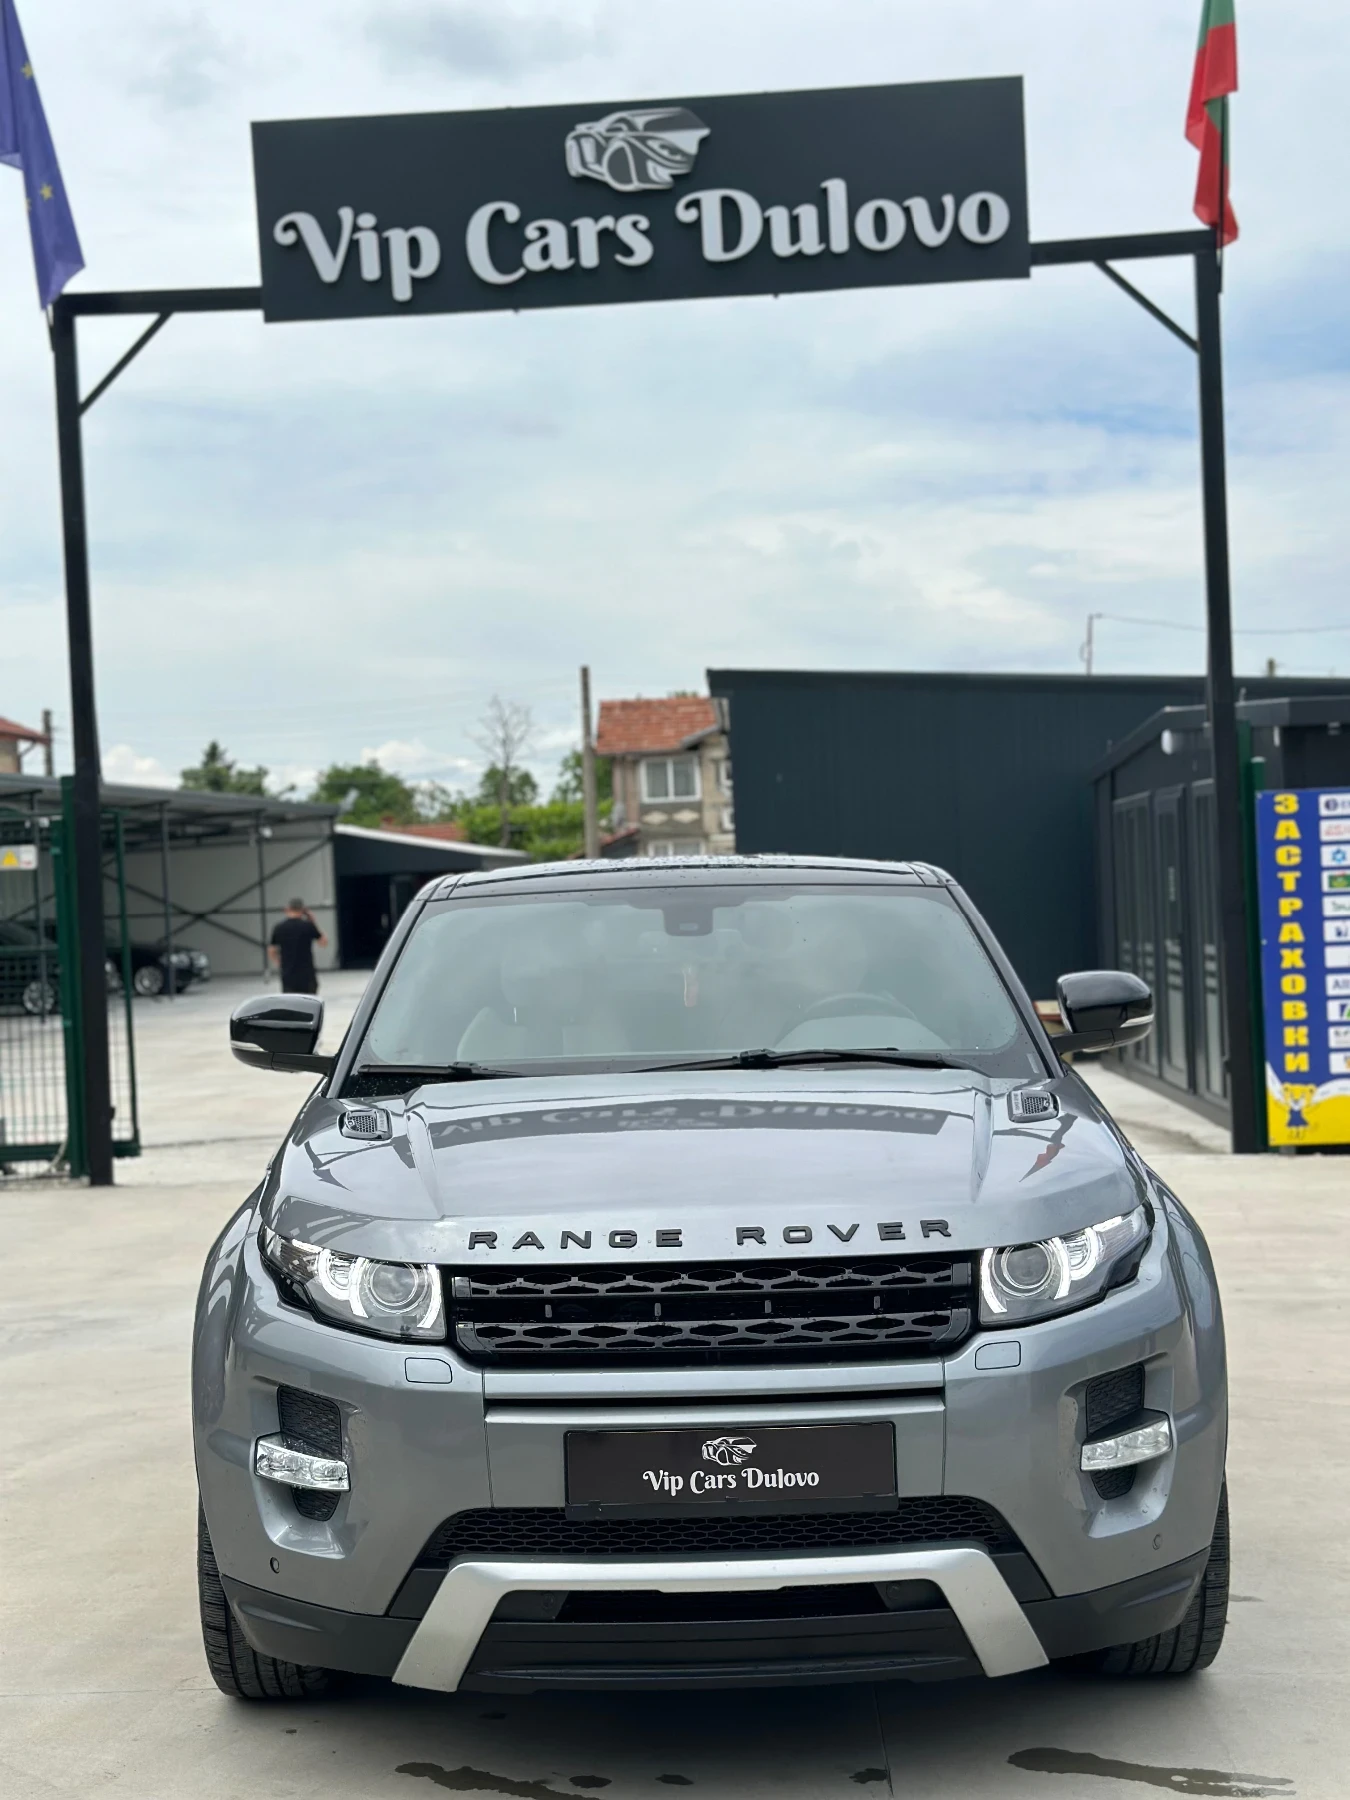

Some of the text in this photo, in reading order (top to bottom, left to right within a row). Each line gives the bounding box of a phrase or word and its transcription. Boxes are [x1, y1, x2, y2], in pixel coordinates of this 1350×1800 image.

[274, 178, 1010, 302] Vip Cars Dulovo
[1273, 793, 1309, 1073] ЗАСТРАХОВКИ
[468, 1220, 952, 1250] RANGE ROVER
[643, 1468, 819, 1496] Vip Cars Dulovo
